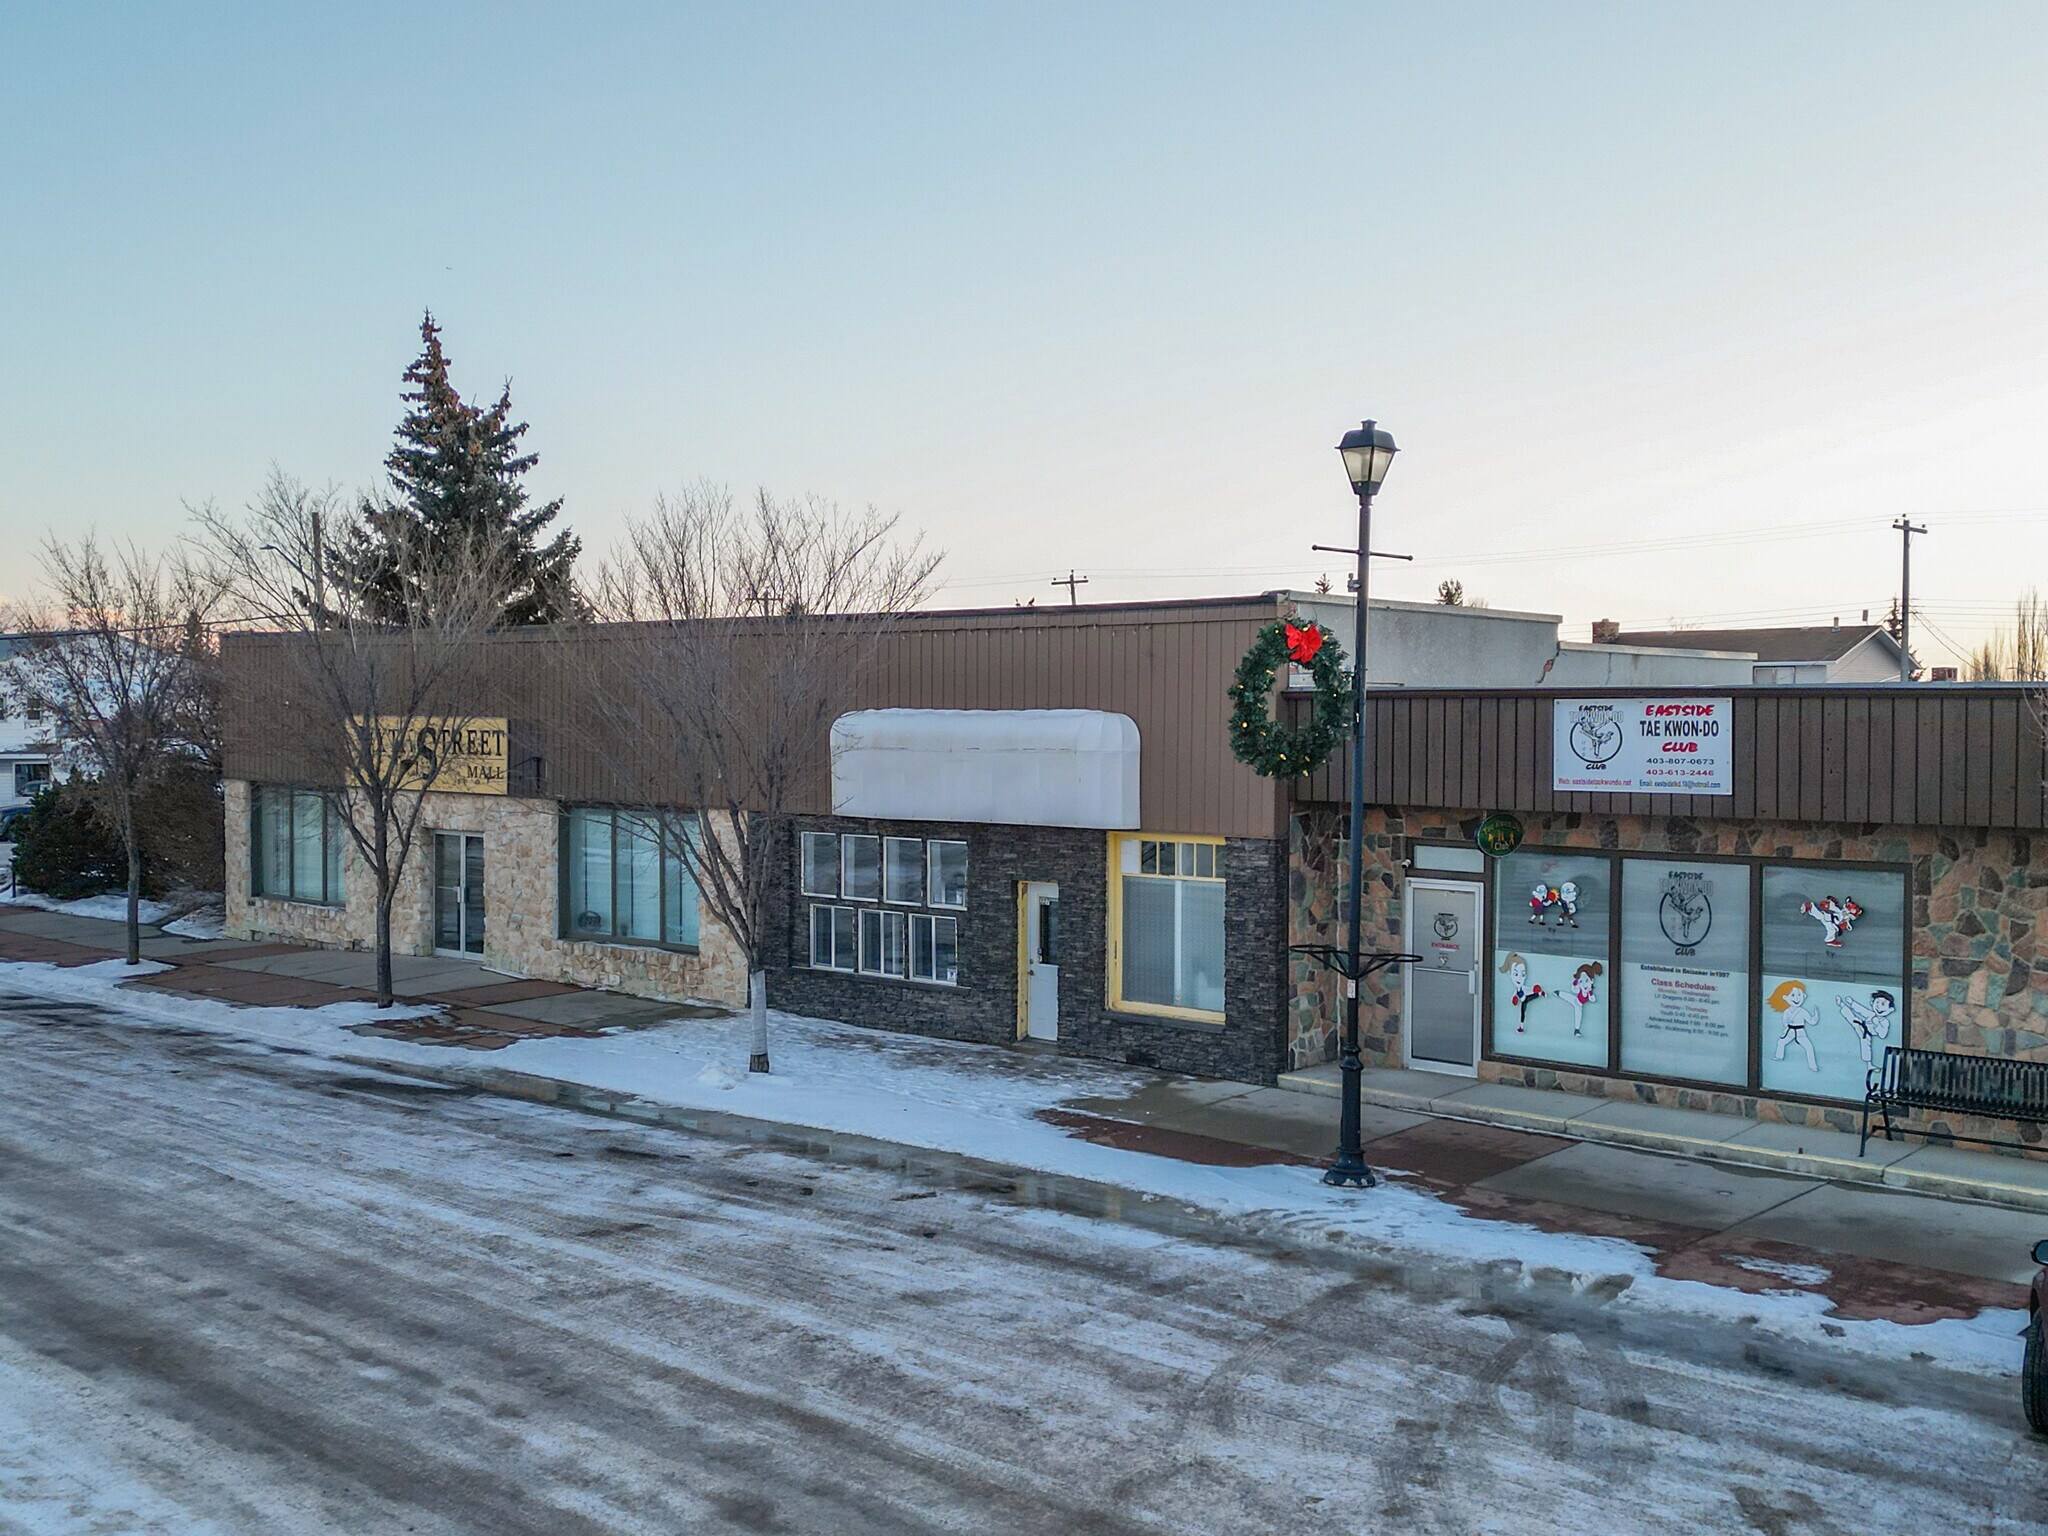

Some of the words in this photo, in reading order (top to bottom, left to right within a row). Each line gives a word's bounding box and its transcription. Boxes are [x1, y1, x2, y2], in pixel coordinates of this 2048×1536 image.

[1646, 704, 1715, 717] EASTSIDE
[1640, 720, 1660, 736] TAE
[1664, 720, 1719, 737] KWON-DO
[1662, 741, 1698, 752] CLUB
[466, 764, 504, 779] MALL
[1431, 942, 1460, 950] ENTRANCE
[1675, 948, 1696, 956] CLUB
[1651, 978, 1673, 987] Class
[1674, 980, 1718, 991] Schedules:
